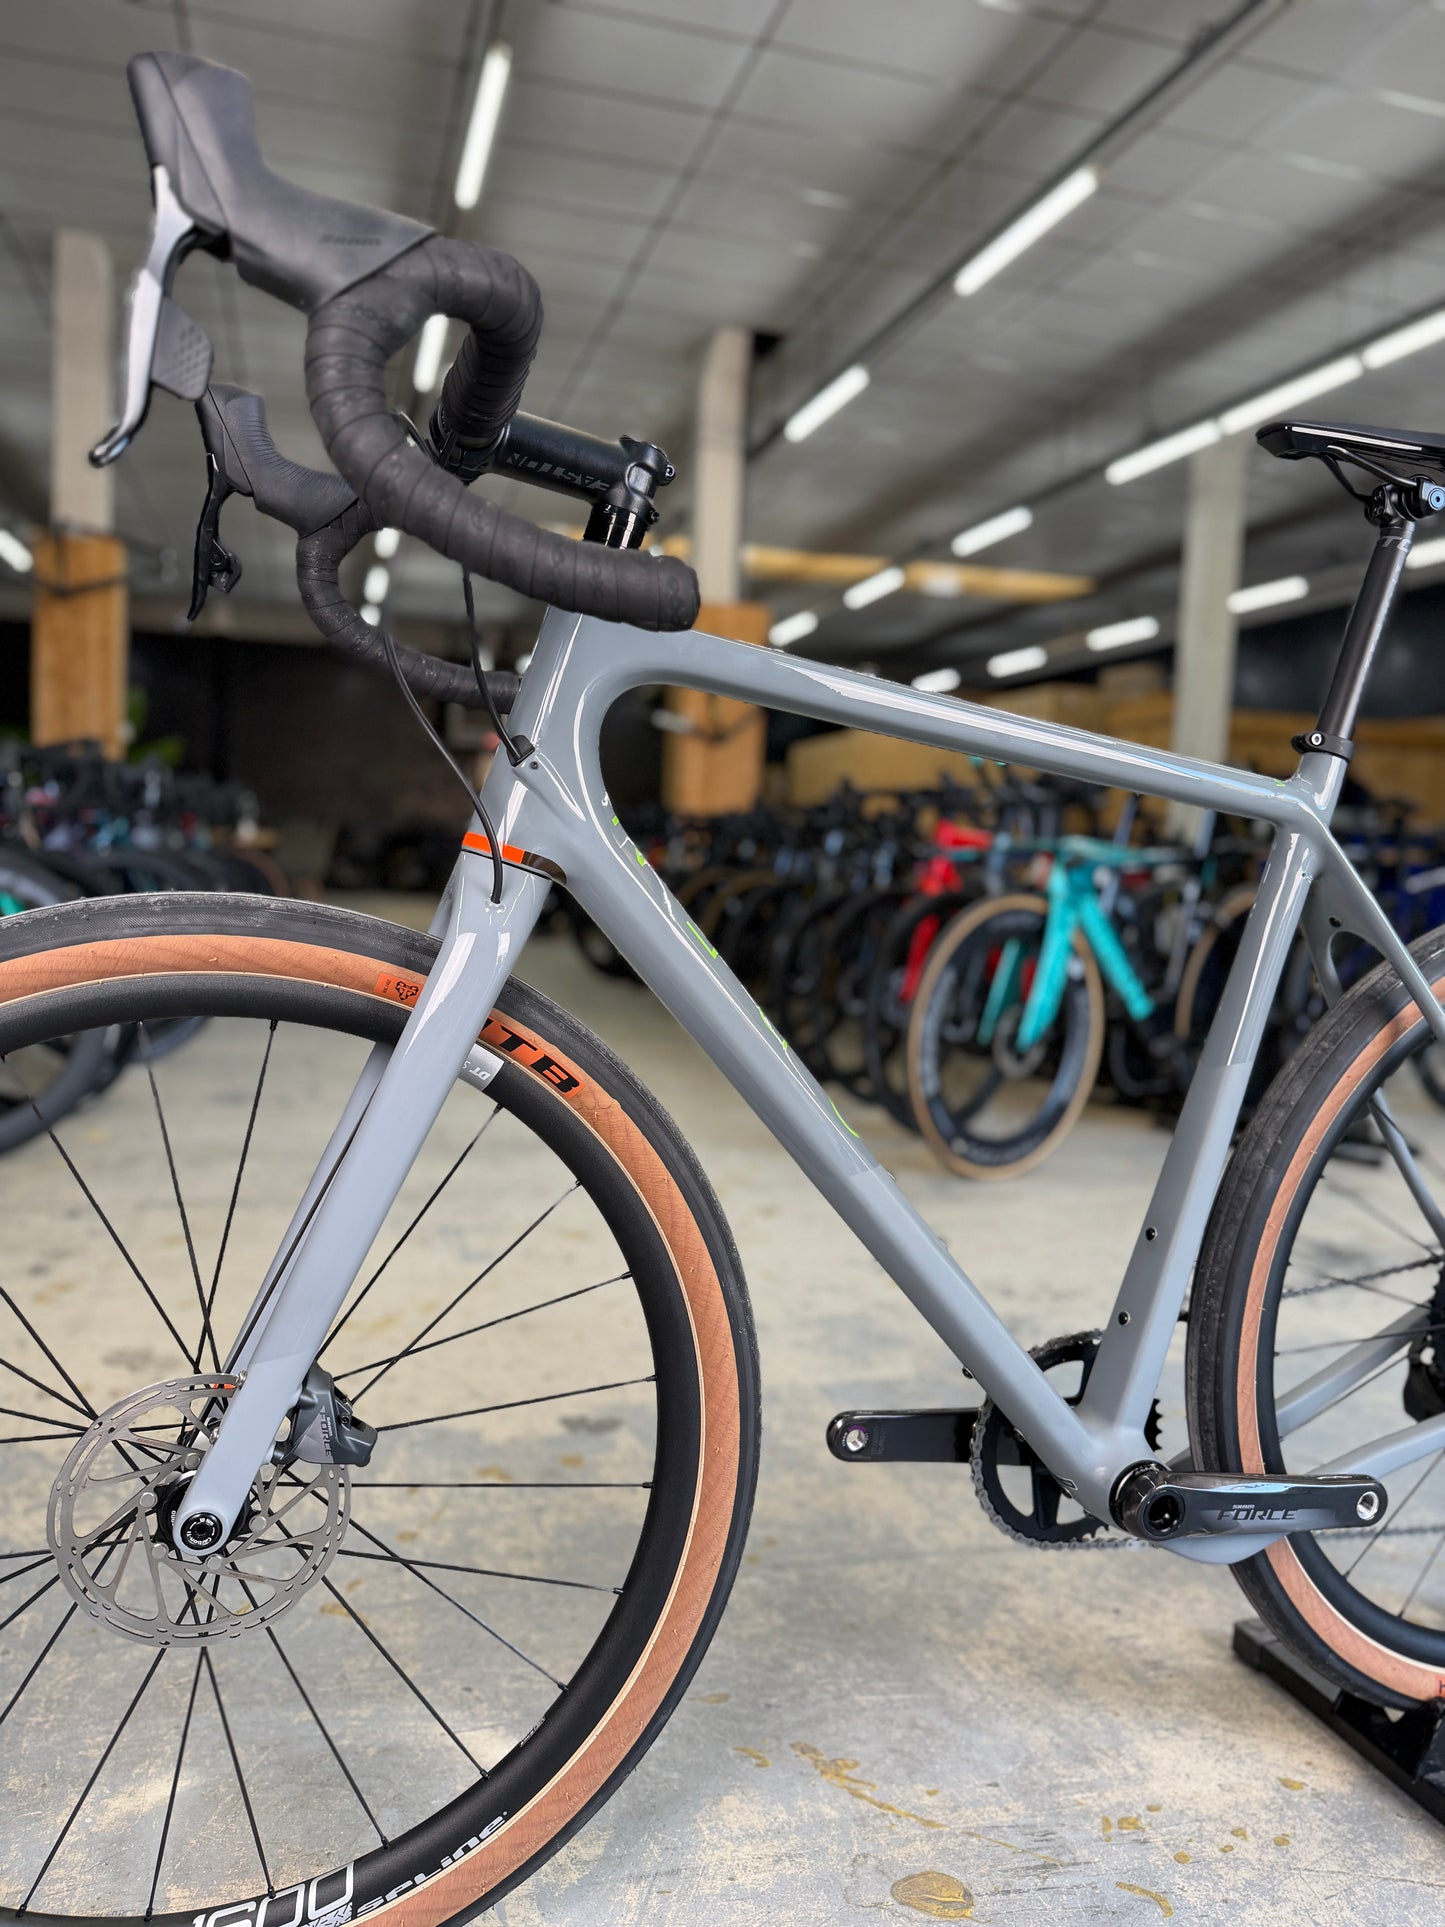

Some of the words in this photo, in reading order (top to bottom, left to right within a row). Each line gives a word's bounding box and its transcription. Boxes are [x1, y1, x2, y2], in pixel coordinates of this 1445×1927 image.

[468, 1066, 491, 1081] DT
[481, 1018, 580, 1093] TB
[320, 1411, 332, 1457] FORCE
[1217, 1508, 1296, 1521] FORCE
[192, 1860, 355, 1927] 600
